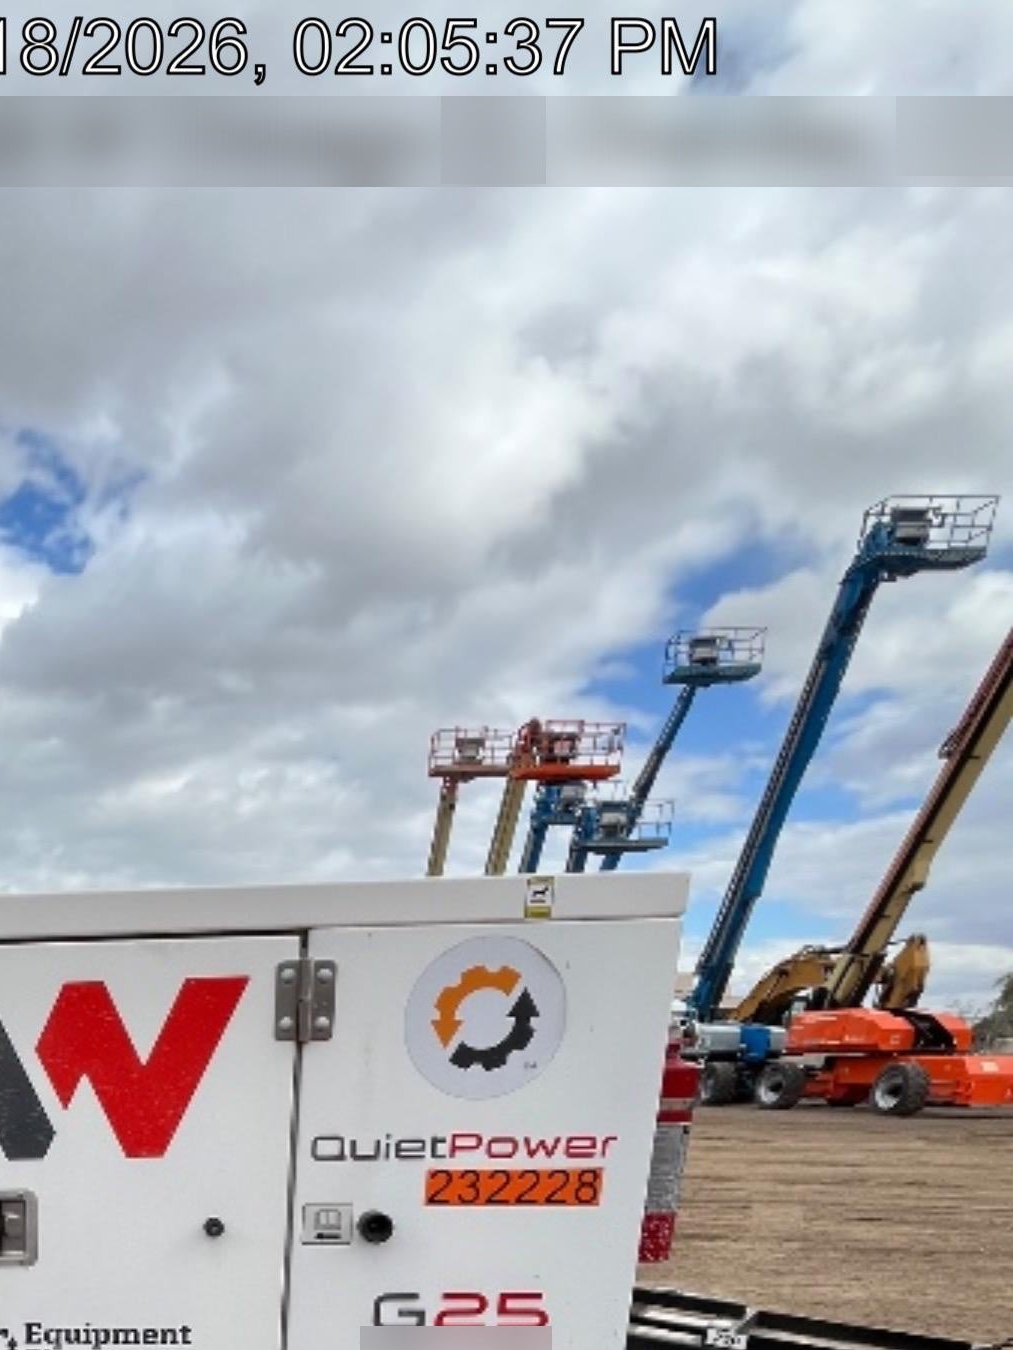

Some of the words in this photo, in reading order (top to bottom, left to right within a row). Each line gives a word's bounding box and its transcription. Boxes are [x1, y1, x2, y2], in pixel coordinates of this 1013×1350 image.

[310, 1132, 618, 1162] QuietPower
[427, 1170, 599, 1204] 232228
[373, 1292, 549, 1327] G25
[24, 1322, 192, 1350] Equipment
